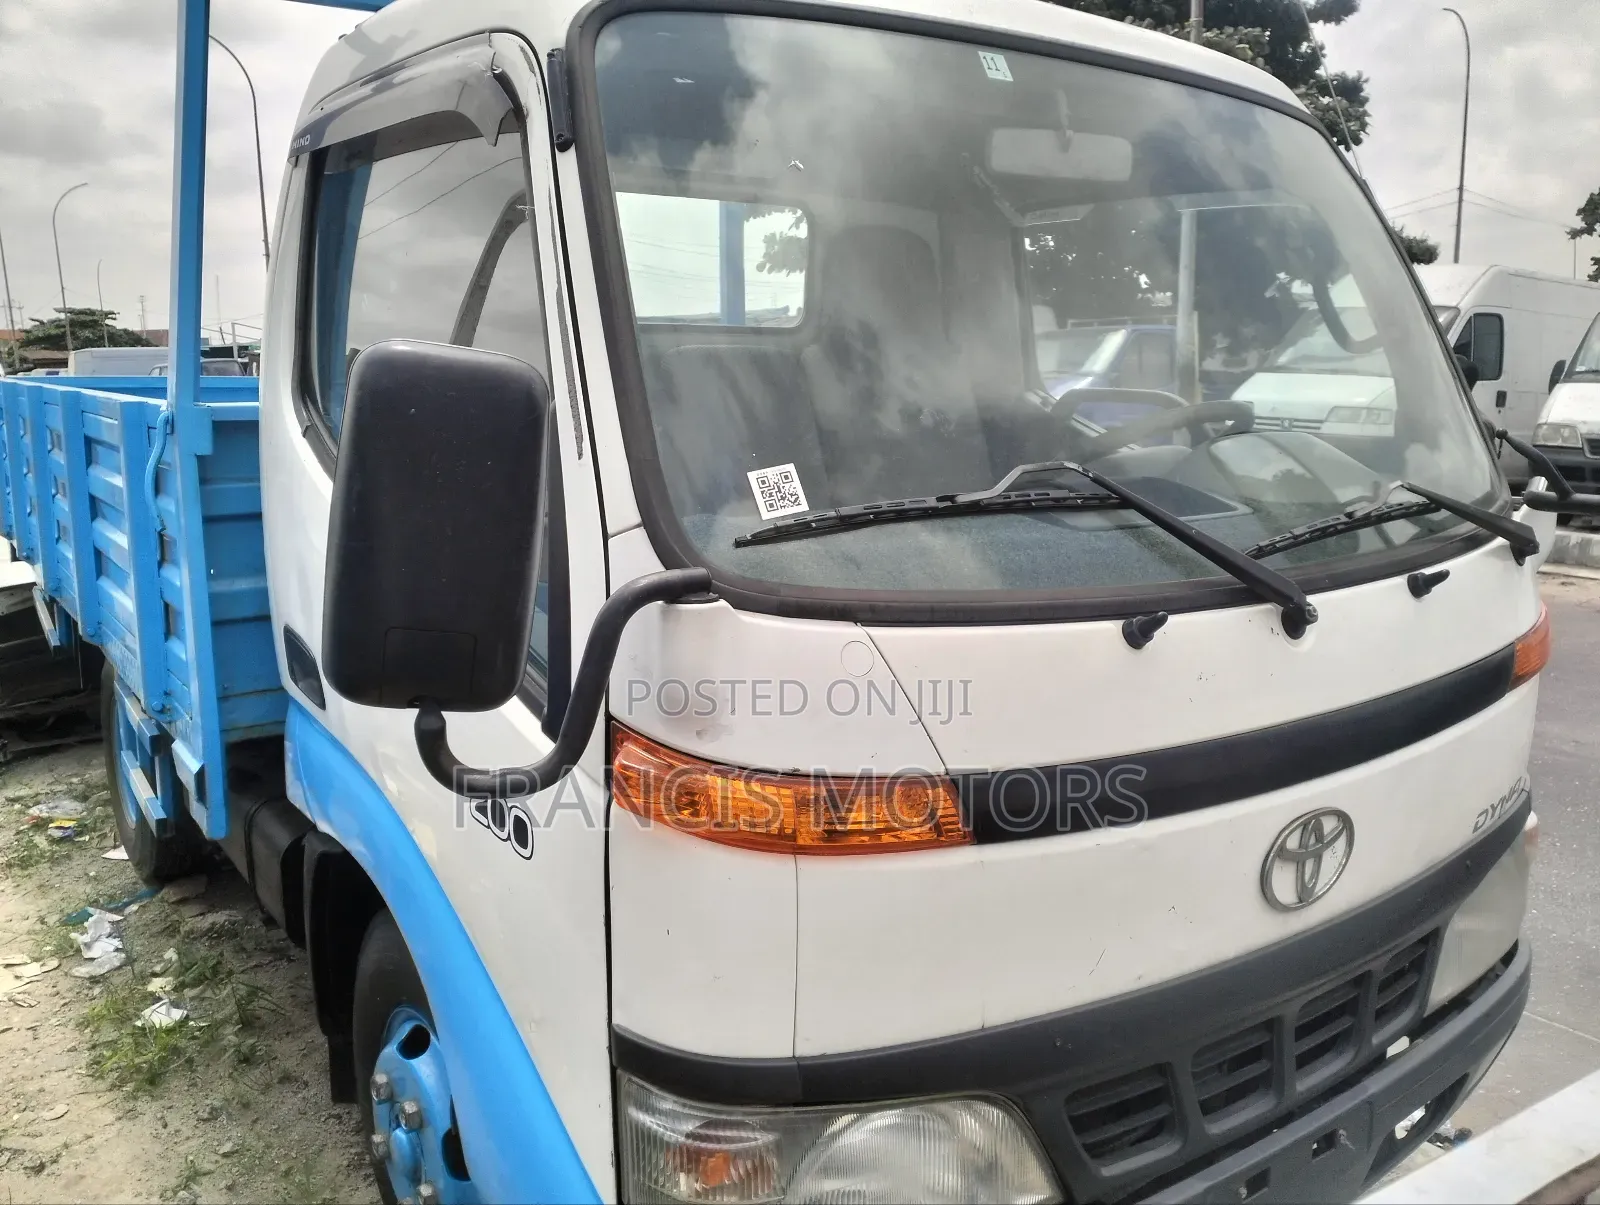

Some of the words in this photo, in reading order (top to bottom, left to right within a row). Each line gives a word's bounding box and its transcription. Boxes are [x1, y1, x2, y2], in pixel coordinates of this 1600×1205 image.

[982, 55, 1001, 72] 11
[291, 134, 311, 150] HINO
[1472, 776, 1522, 834] DYNA
